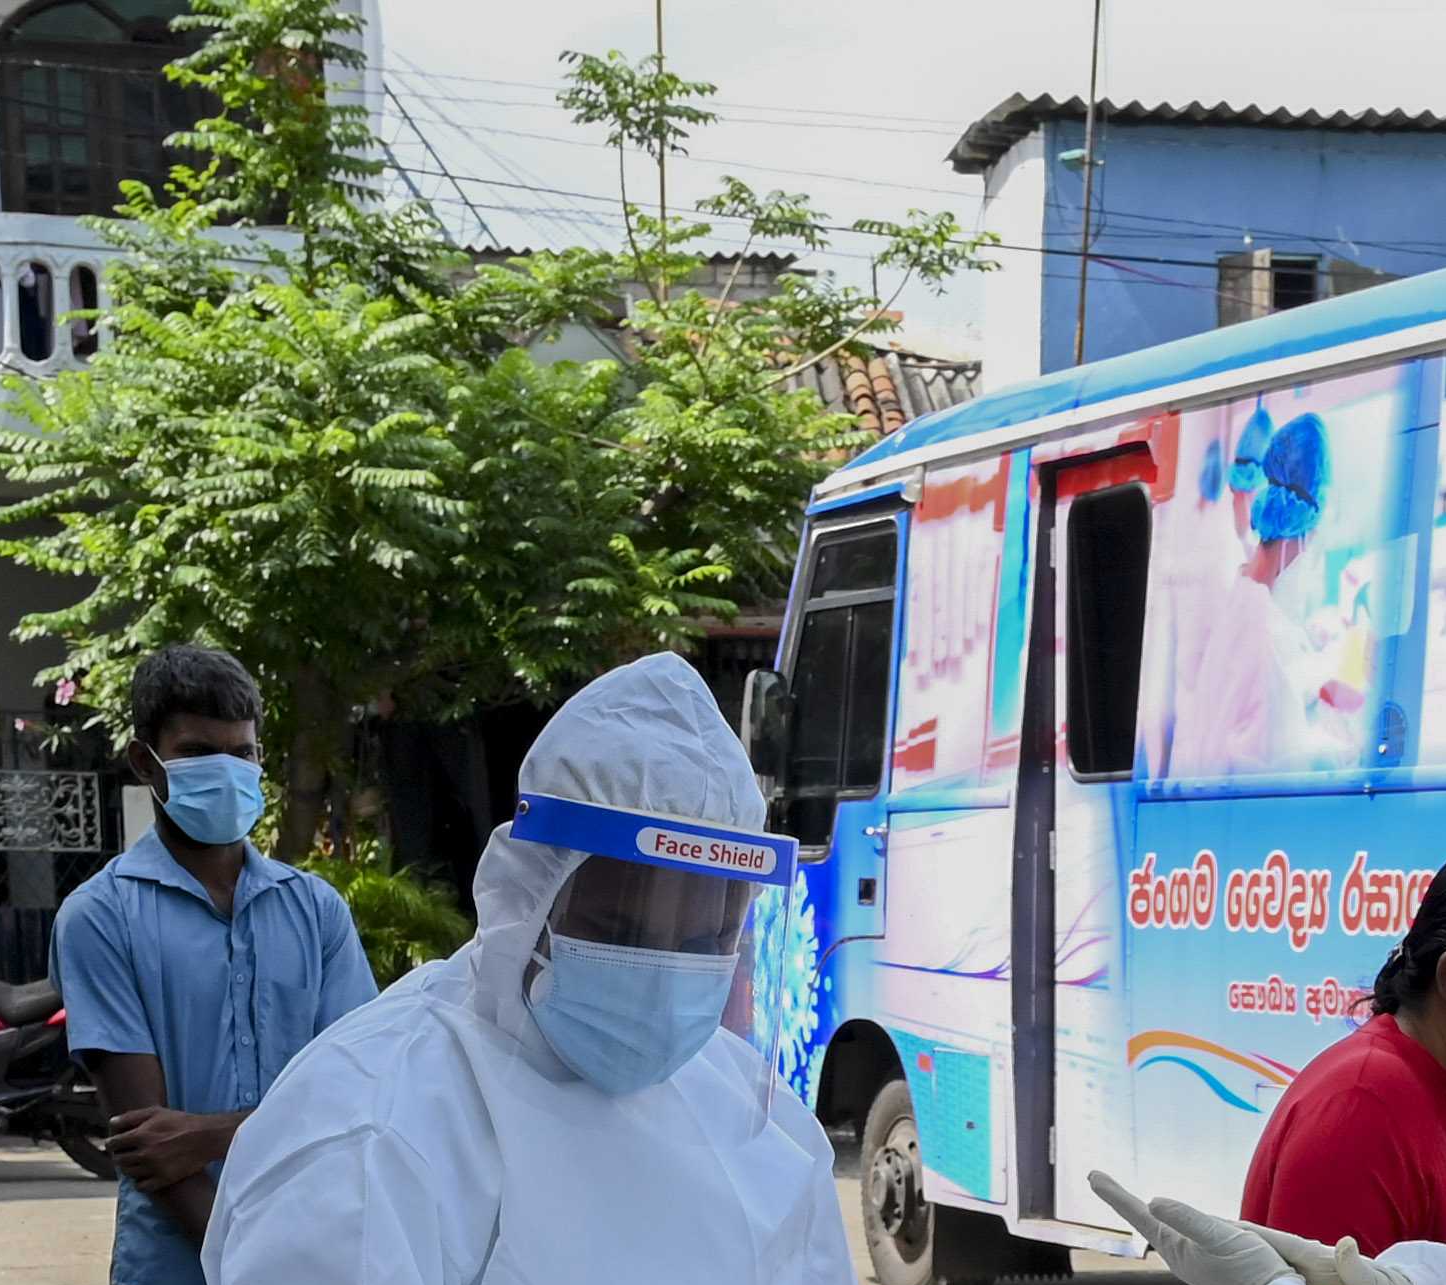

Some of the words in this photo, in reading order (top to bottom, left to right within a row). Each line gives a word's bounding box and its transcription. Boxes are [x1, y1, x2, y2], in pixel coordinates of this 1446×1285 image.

[654, 833, 703, 860] Face
[708, 840, 765, 870] Shield
[1128, 850, 1217, 929] ජංගම
